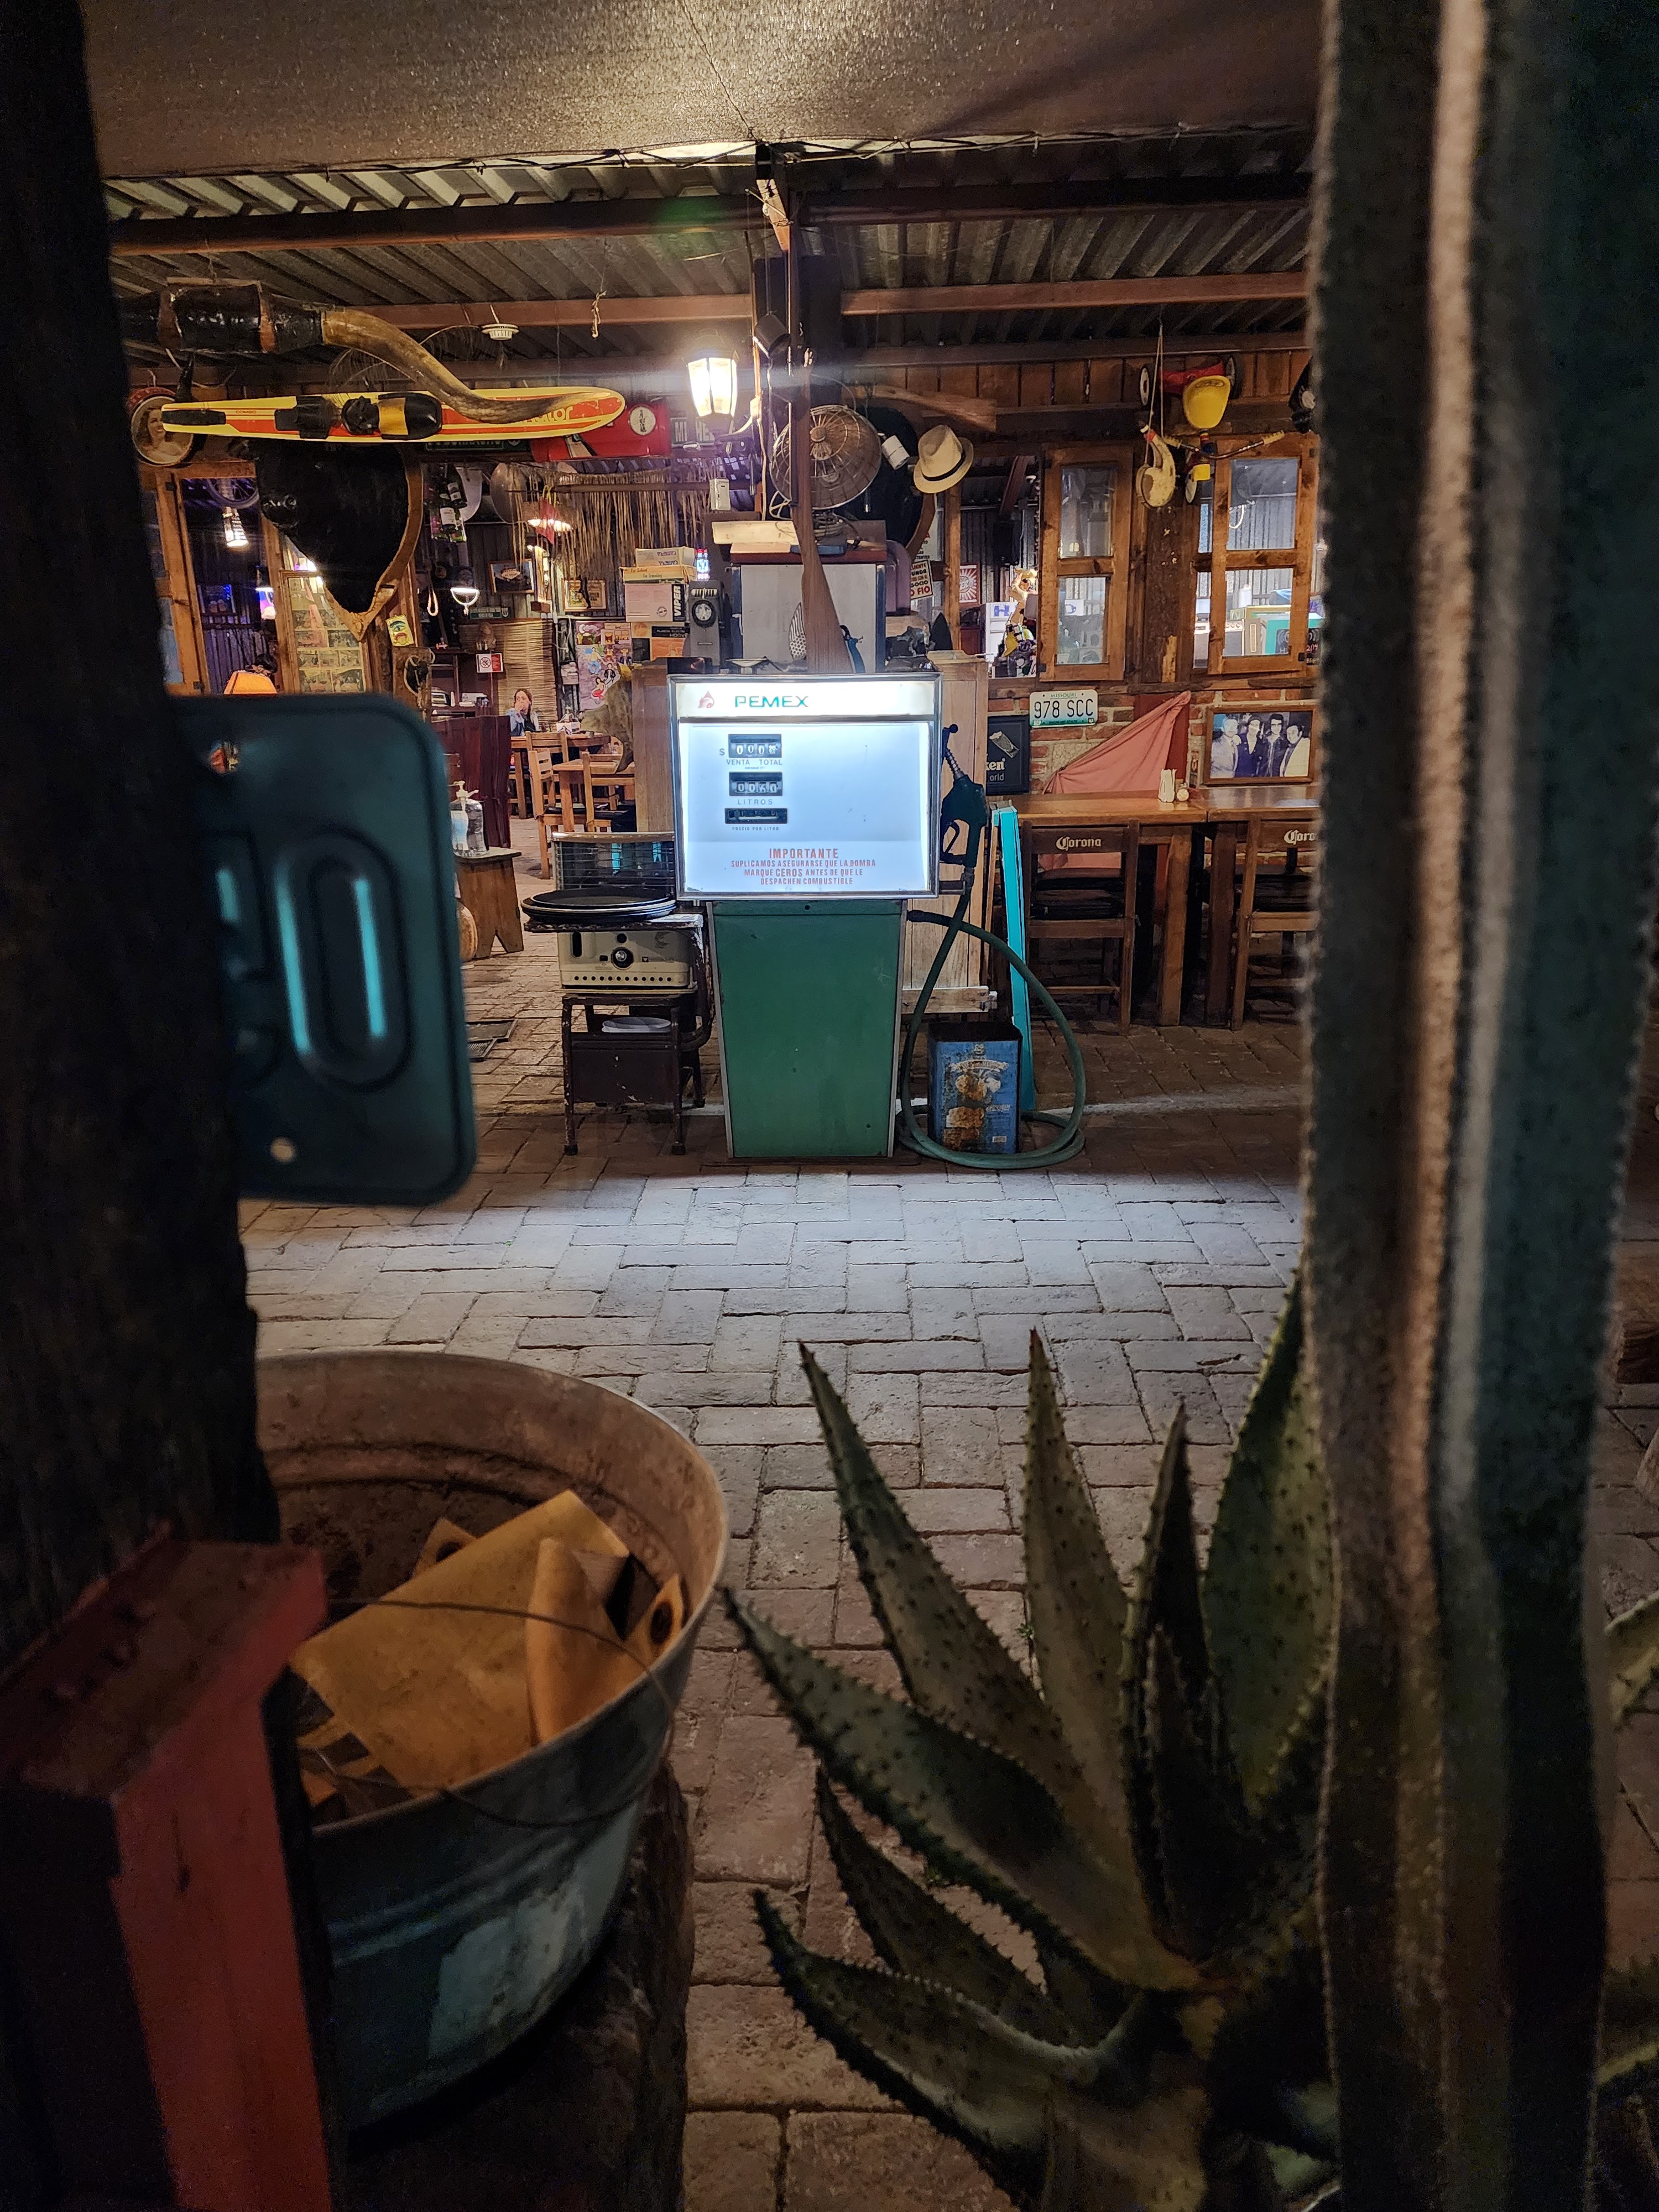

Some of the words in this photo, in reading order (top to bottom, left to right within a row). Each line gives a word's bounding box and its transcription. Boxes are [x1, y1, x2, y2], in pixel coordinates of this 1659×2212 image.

[911, 580, 928, 588] GOCIO
[917, 585, 931, 595] FIO
[673, 585, 681, 617] VIPER
[735, 696, 809, 708] PEMEX
[1034, 700, 1060, 719] 978
[1067, 698, 1093, 717] SCC
[1056, 836, 1102, 852] Corona
[769, 848, 839, 859] IMPORTANTE
[825, 859, 837, 868] QUE
[744, 869, 773, 877] MARQUE
[775, 868, 803, 877] CEROS
[841, 868, 853, 877] QUE
